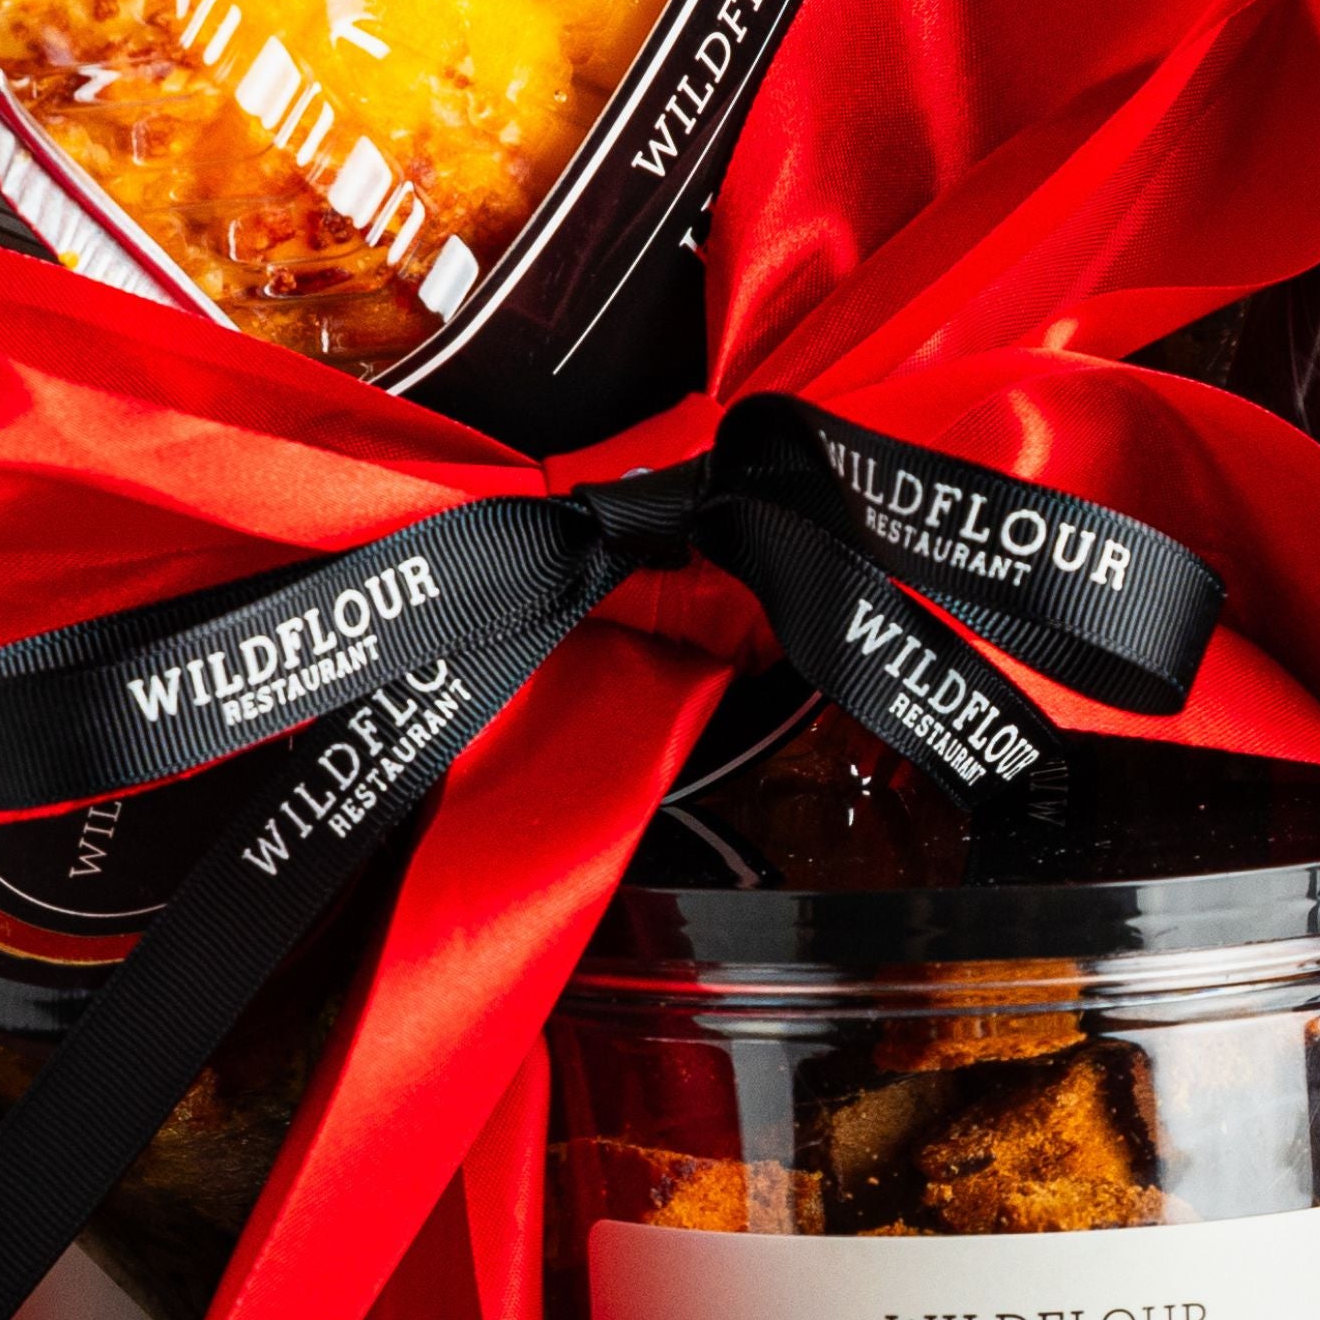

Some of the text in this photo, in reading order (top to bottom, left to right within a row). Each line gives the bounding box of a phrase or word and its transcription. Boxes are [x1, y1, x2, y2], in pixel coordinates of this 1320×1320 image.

[818, 429, 1132, 591] WILDFLOUR
[865, 507, 1031, 586] RESTAURANT
[127, 555, 440, 722] WILDFLOUR
[222, 634, 380, 725] RESTAURANT
[845, 598, 1039, 781] WILDFLOUR
[328, 678, 471, 838] RESTAURANT
[888, 692, 986, 787] RESTAURANT
